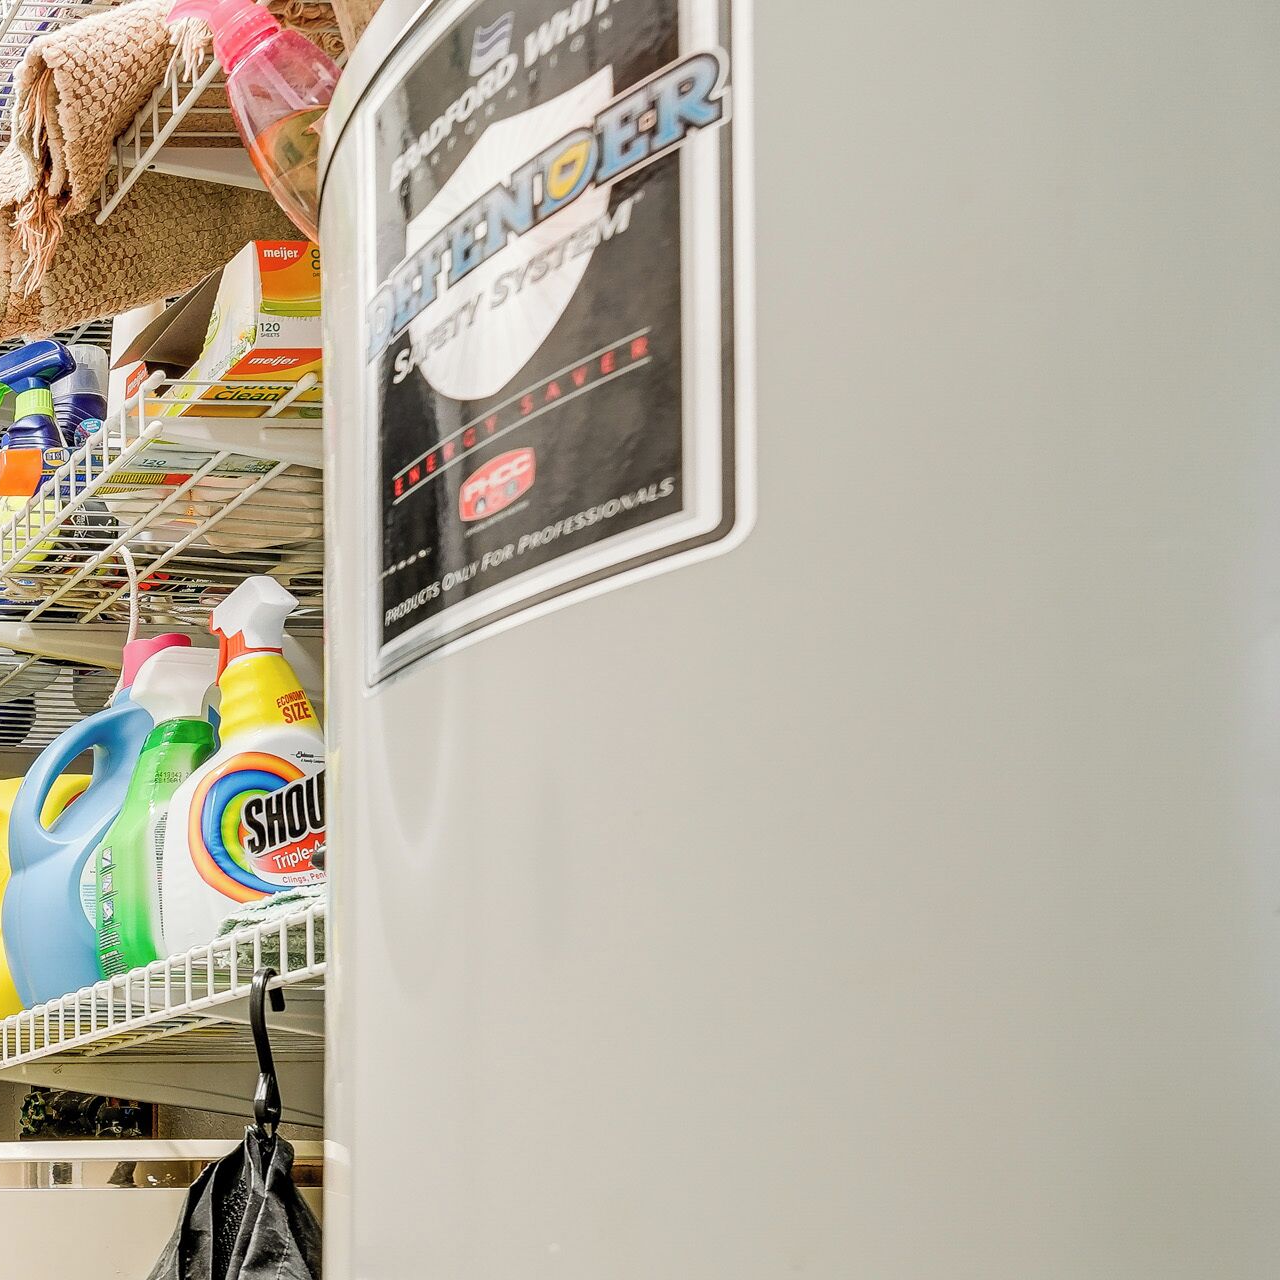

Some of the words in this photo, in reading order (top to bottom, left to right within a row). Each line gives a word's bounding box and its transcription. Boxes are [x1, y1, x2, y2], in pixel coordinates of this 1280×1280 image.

[366, 52, 730, 362] DEFENDER
[263, 248, 299, 260] meijer
[260, 322, 281, 332] 120
[248, 356, 300, 366] meijer
[214, 390, 280, 401] Clean
[394, 415, 497, 498] ENERGY
[518, 336, 648, 416] SAVER
[142, 458, 167, 467] 120
[465, 452, 530, 501] PHCC
[385, 581, 441, 627] PRODUCTS
[442, 565, 478, 592] ONLY
[481, 545, 514, 573] FOR
[517, 476, 676, 555] PROFESSIONALS
[276, 690, 307, 708] ECONOMY
[282, 700, 312, 724] SIZE
[282, 873, 309, 885] Clings,
